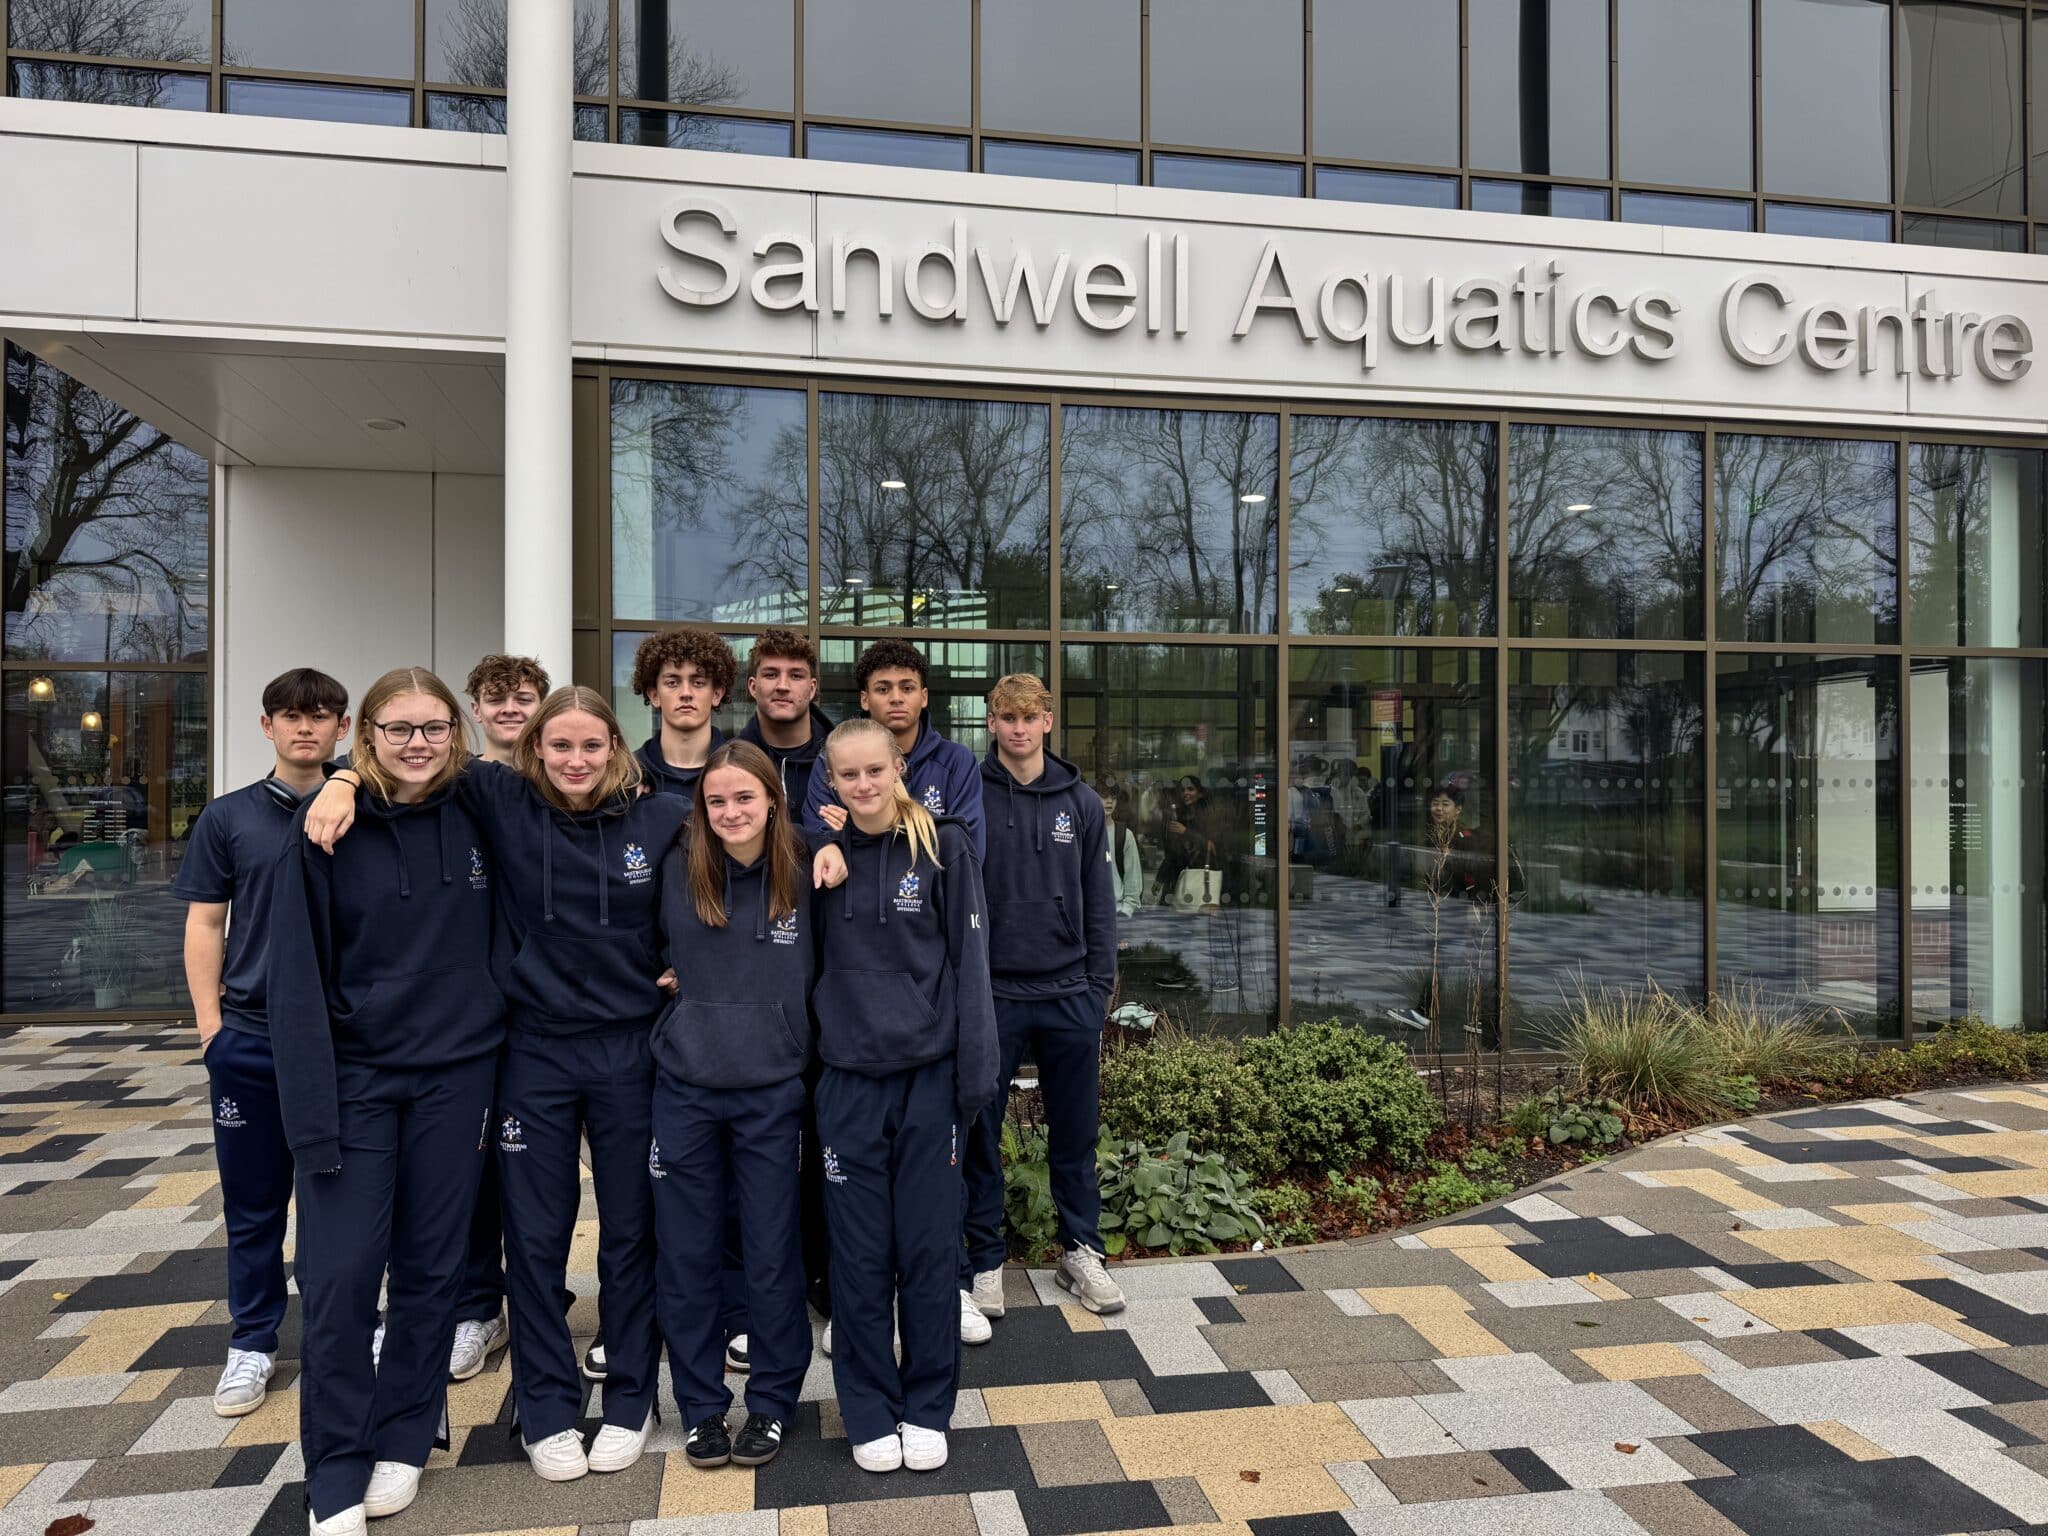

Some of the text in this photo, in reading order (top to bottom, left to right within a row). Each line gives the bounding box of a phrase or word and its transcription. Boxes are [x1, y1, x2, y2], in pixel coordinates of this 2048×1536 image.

[657, 197, 2034, 382] Sandwell Aquatics Centre
